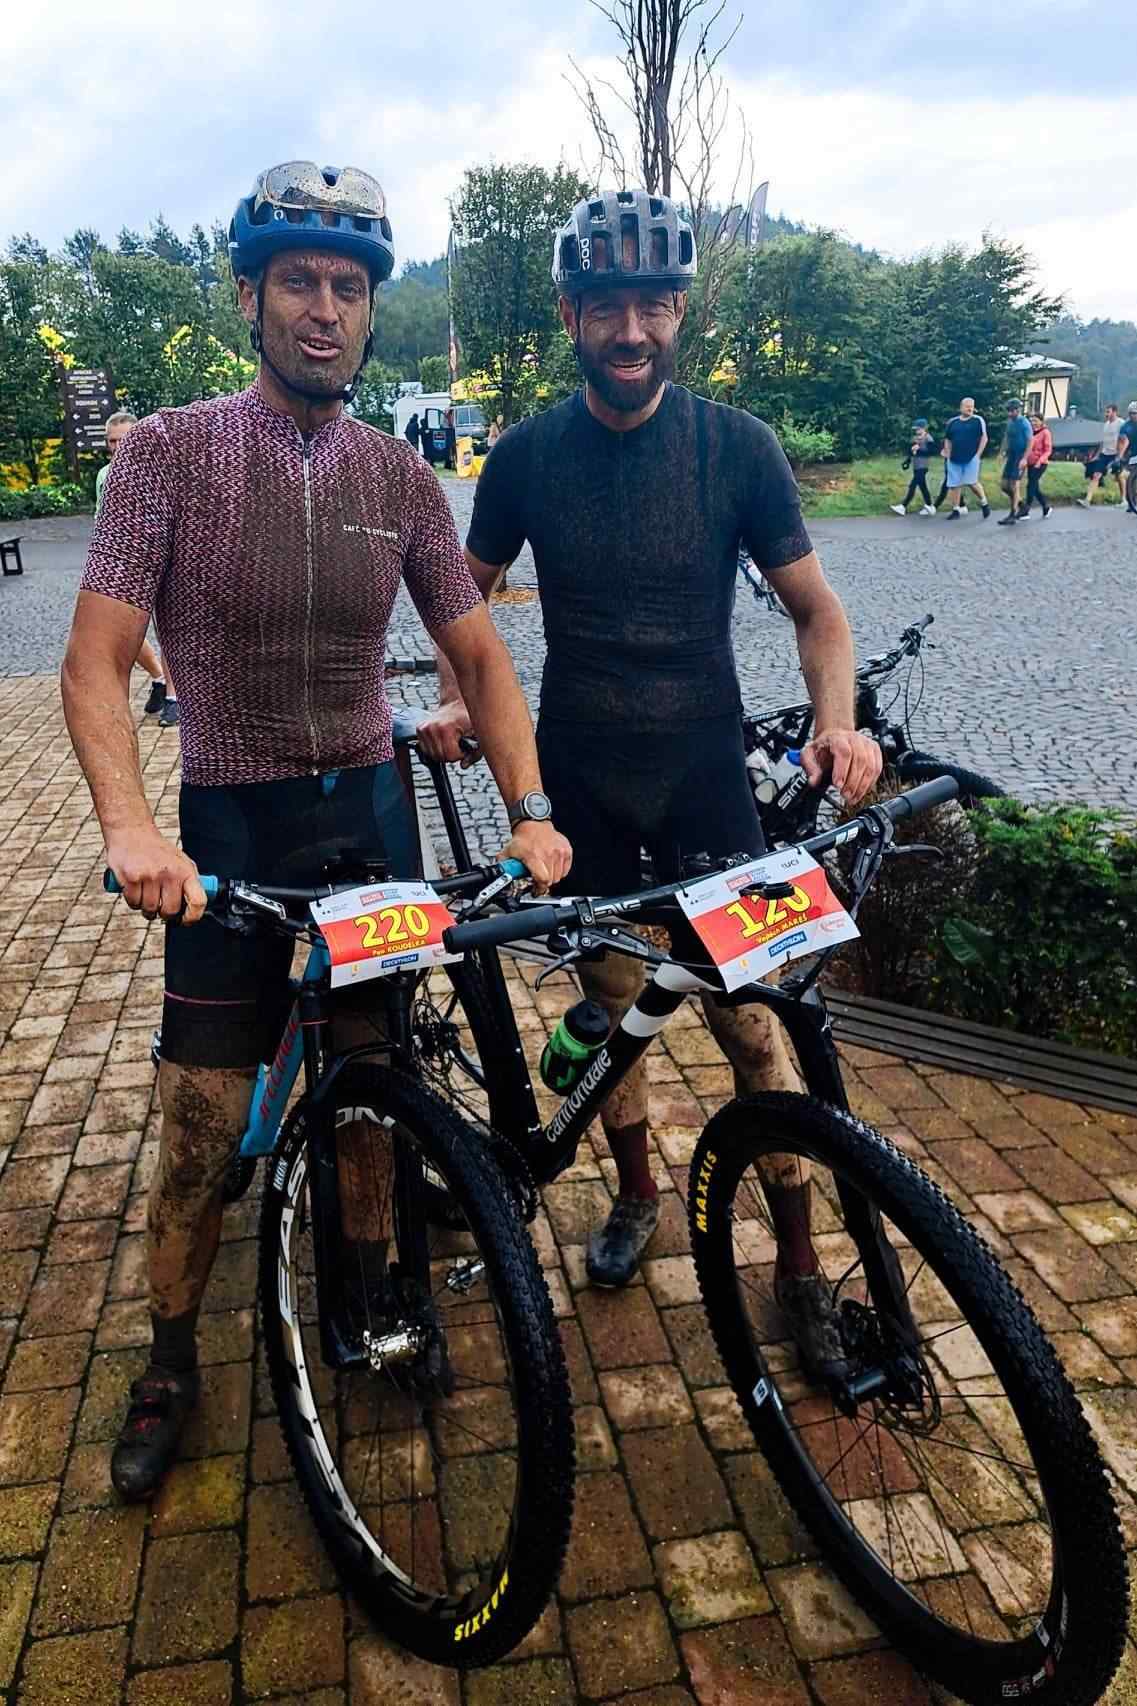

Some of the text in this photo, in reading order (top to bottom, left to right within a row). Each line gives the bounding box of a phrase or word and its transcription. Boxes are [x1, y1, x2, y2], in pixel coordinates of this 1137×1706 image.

[580, 238, 591, 271] POC
[354, 905, 430, 949] 220
[725, 884, 812, 939] 120
[546, 1047, 612, 1143] cannondale
[696, 1150, 717, 1233] MAXXIS
